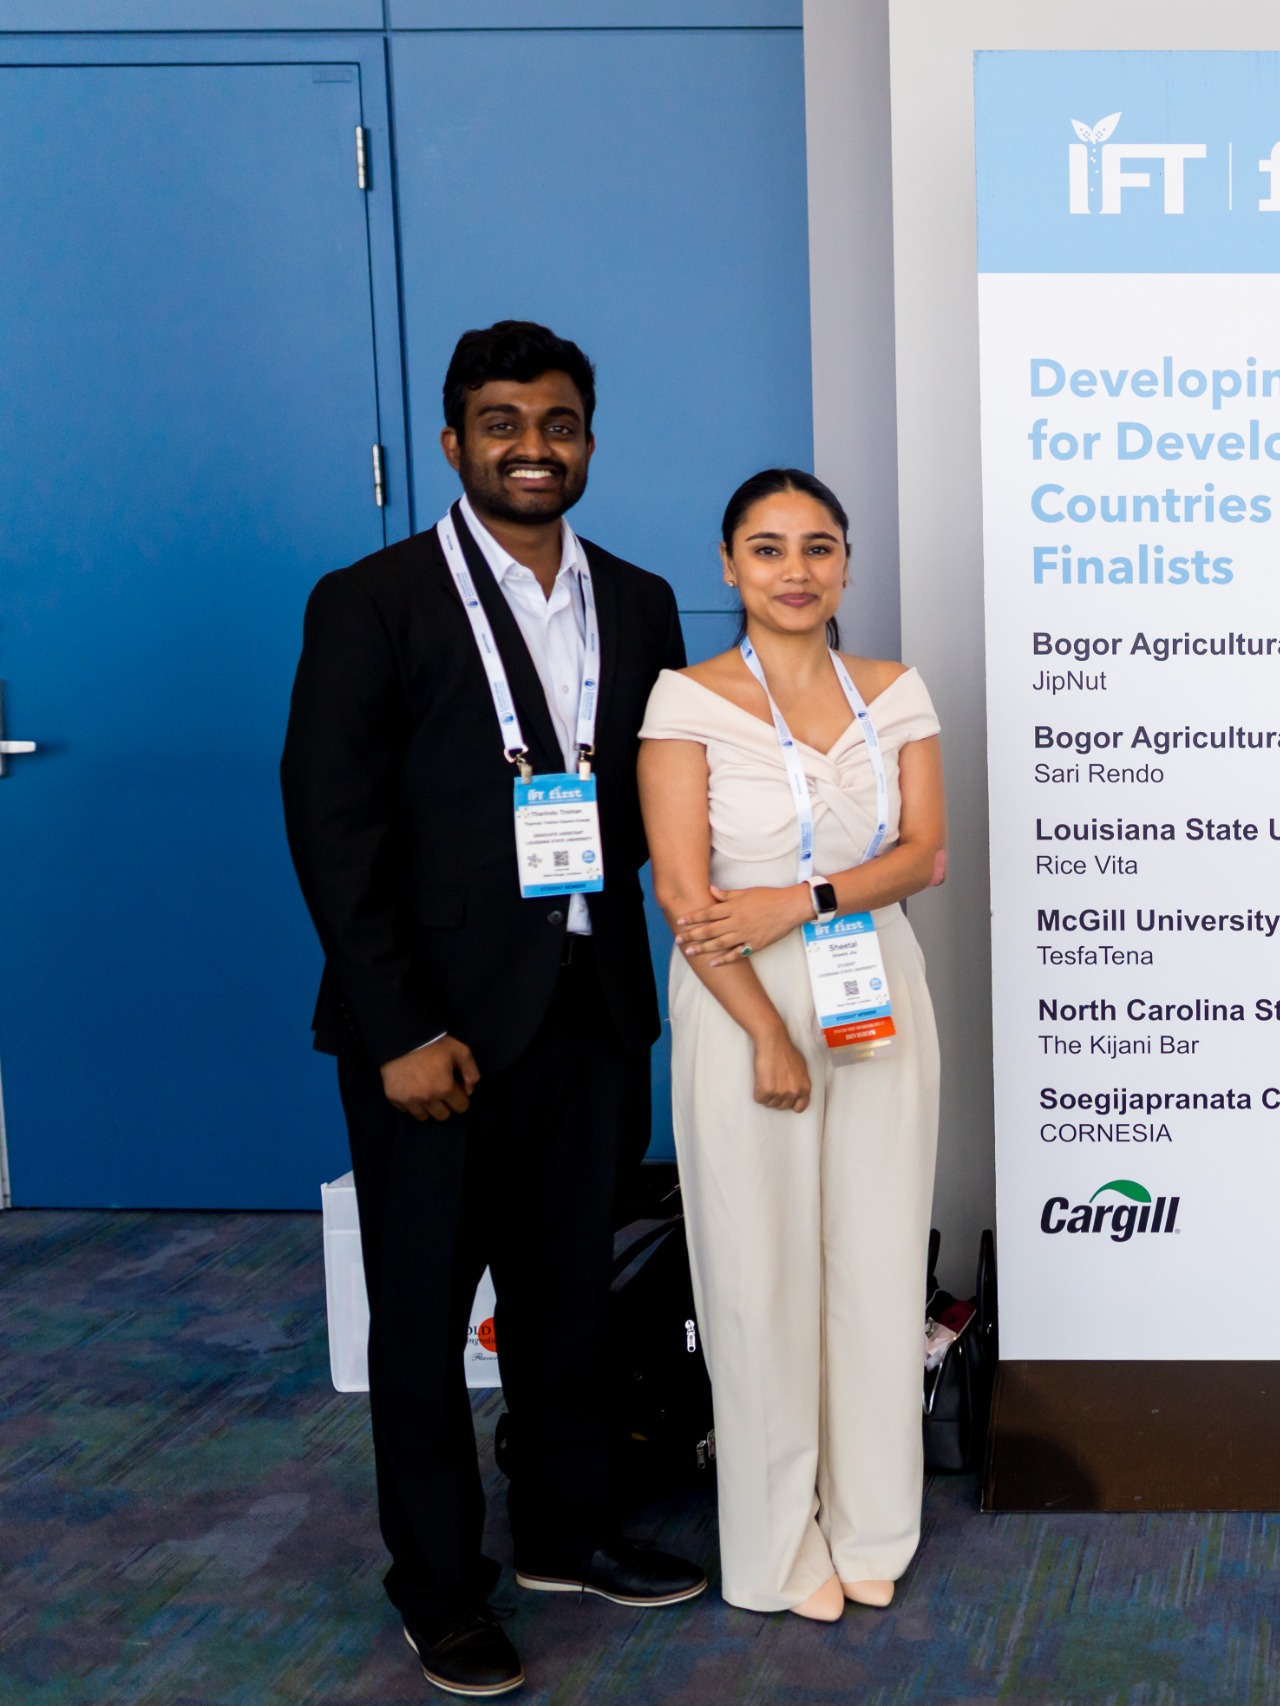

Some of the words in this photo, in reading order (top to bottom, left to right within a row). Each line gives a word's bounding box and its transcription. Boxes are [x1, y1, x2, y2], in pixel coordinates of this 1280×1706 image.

[1068, 130, 1207, 215] IFT
[1028, 418, 1101, 461] for
[1031, 483, 1272, 523] Countries
[1033, 544, 1234, 585] Finalists
[1032, 632, 1123, 661] Bogor
[1032, 670, 1108, 694] JipNut
[1034, 726, 1124, 755] Bogor
[1034, 763, 1080, 784] Sari
[1088, 763, 1165, 784] Rendo
[1035, 818, 1176, 842] Louisiana
[1185, 818, 1259, 842] State
[1035, 855, 1087, 876] Rice
[1094, 855, 1139, 876] Vita
[1036, 908, 1126, 933] McGill
[1136, 908, 1280, 937] University
[829, 941, 857, 951] Sheetal
[1036, 945, 1154, 966] TesfaTena
[1038, 998, 1117, 1022] North
[1126, 998, 1246, 1022] Carolina
[1037, 1034, 1082, 1055] The
[1090, 1034, 1152, 1059] Kijani
[1159, 1034, 1200, 1055] Bar
[1039, 1086, 1252, 1116] Soegijapranata
[1039, 1123, 1173, 1144] CORNESIA
[1040, 1195, 1179, 1243] Cargill
